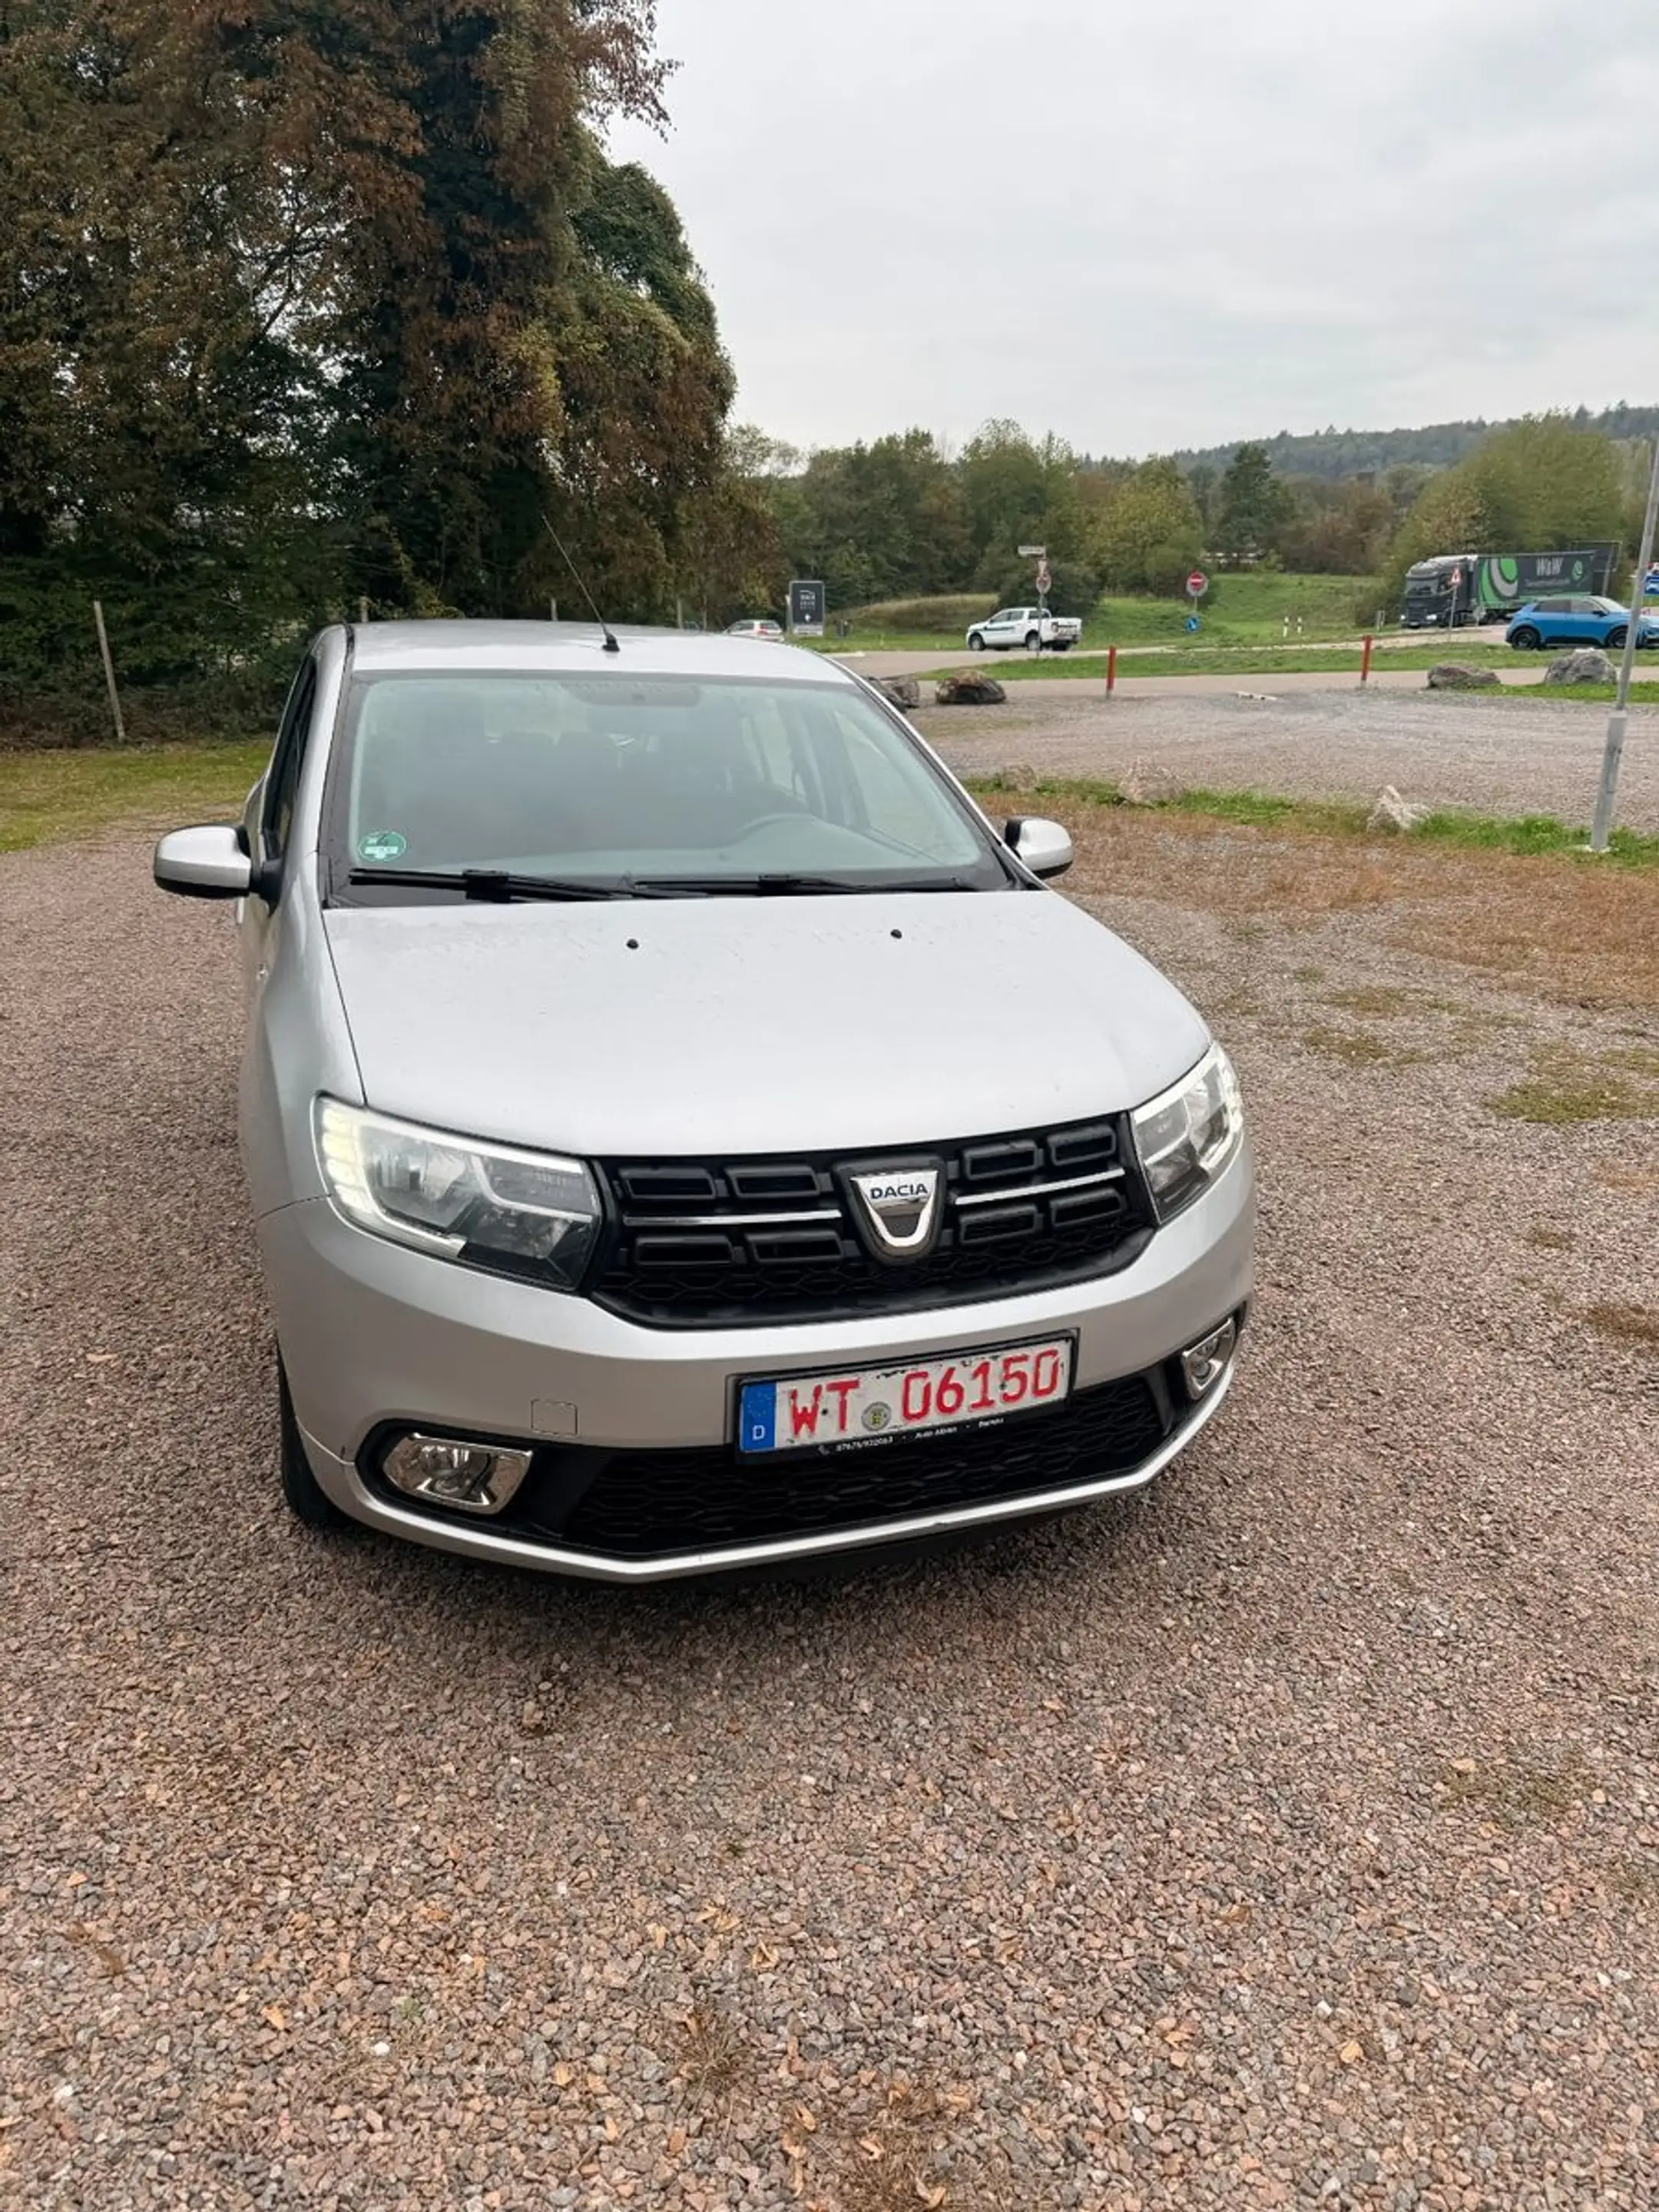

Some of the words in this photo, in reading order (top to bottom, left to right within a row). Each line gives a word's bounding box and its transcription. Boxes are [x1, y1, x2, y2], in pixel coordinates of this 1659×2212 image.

[870, 1183, 929, 1199] DACIA
[789, 1377, 862, 1438] WT
[902, 1349, 1060, 1421] 06150
[752, 1425, 766, 1442] D
